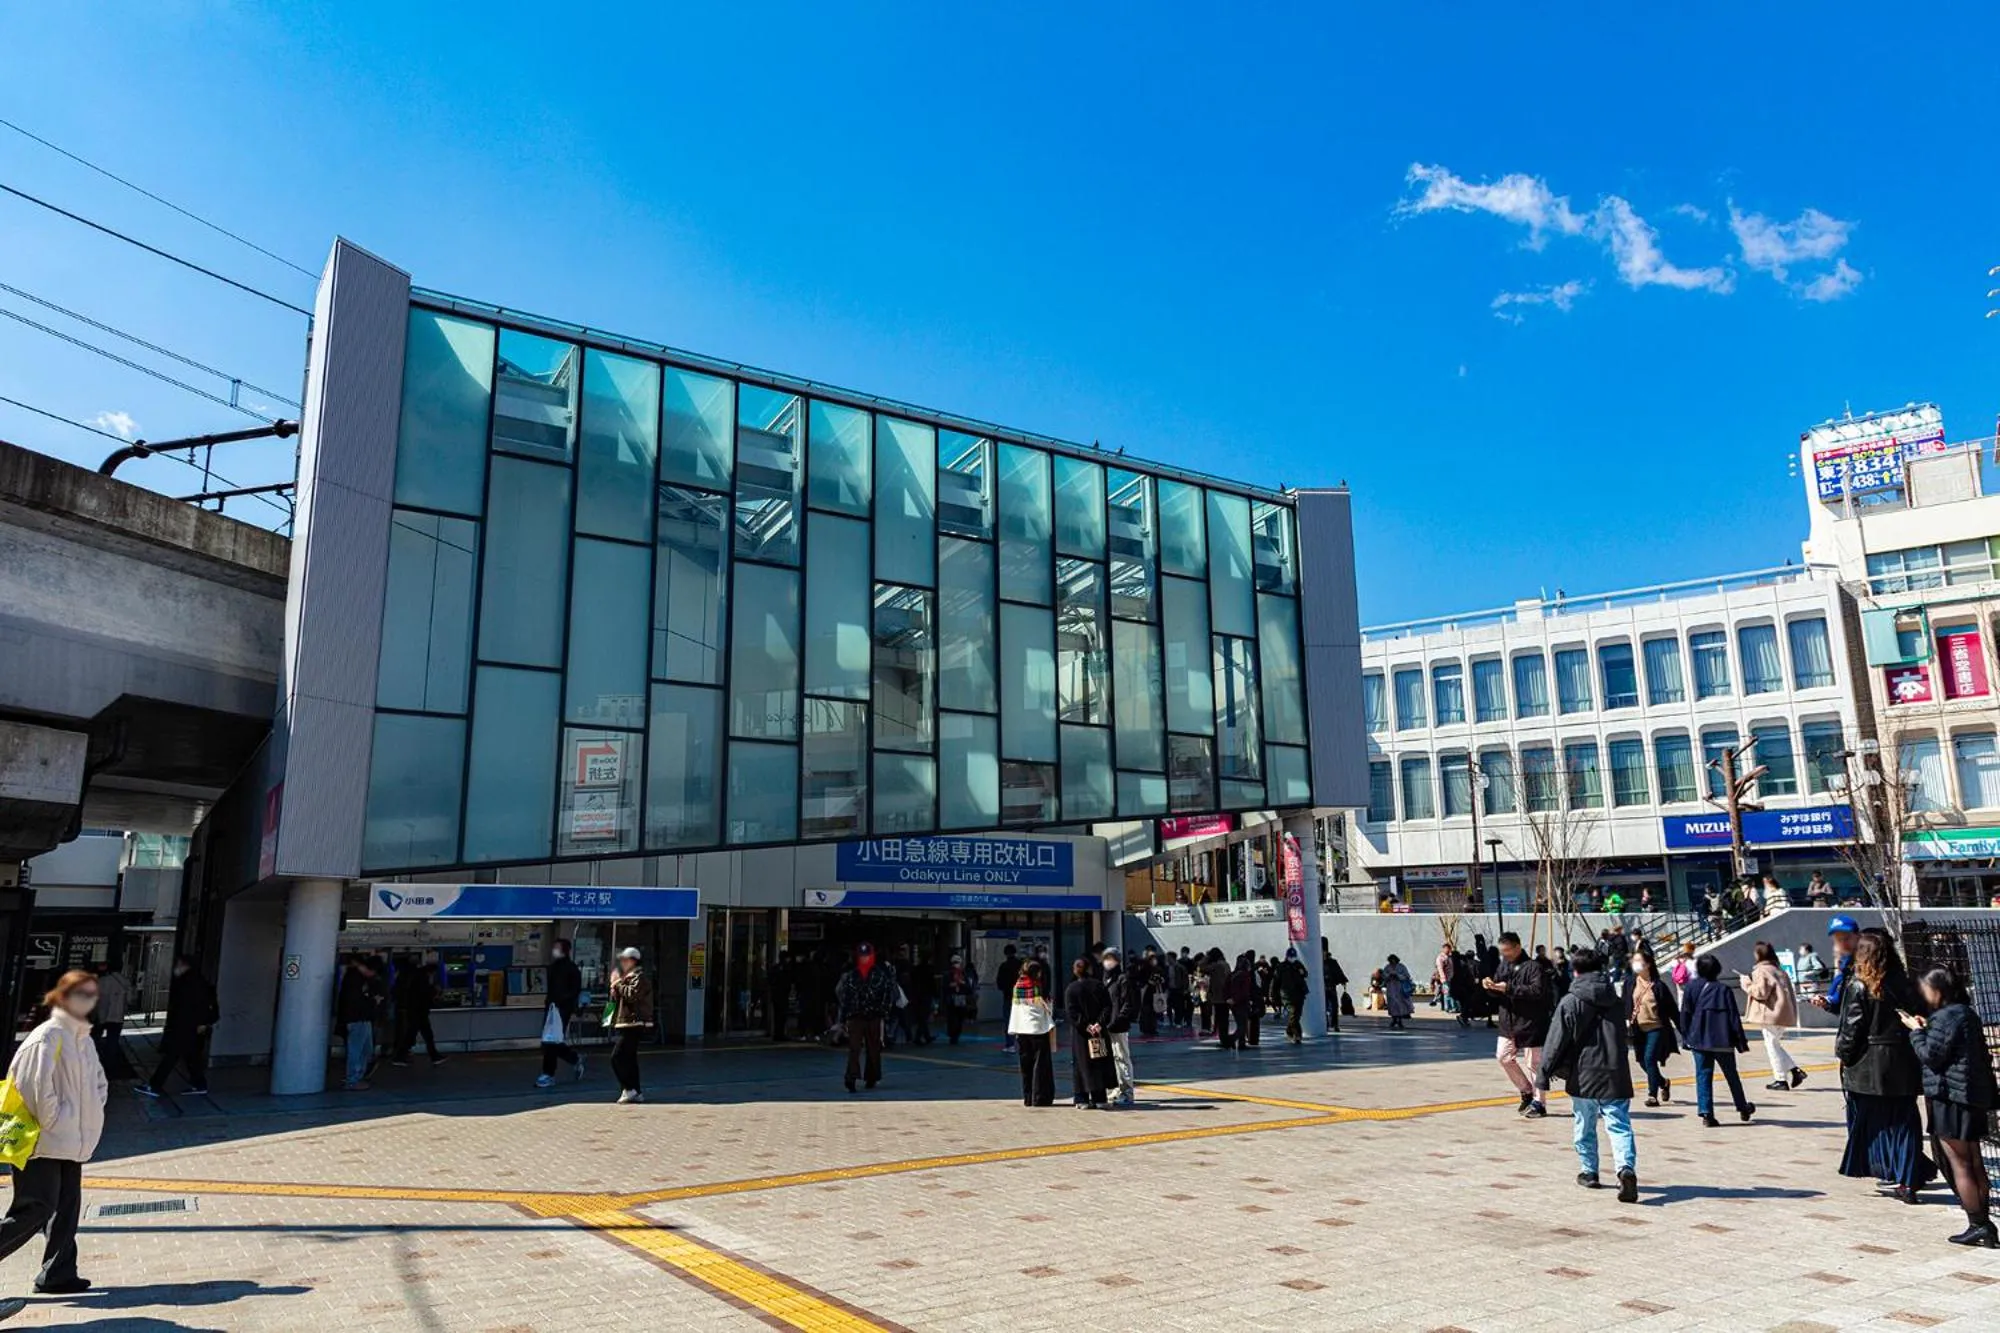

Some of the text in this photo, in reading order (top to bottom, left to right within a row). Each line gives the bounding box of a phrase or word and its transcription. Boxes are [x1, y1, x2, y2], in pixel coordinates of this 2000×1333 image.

[1780, 811, 1832, 823] みずほ銀行
[1685, 821, 1733, 834] MIZUH
[1781, 824, 1834, 836] みずほ証券
[857, 838, 1056, 868] 小田急線専用改札口
[1949, 839, 2000, 854] Family
[899, 867, 1021, 883] Odakyu Line ONLY
[552, 891, 612, 905] 下北沢駅
